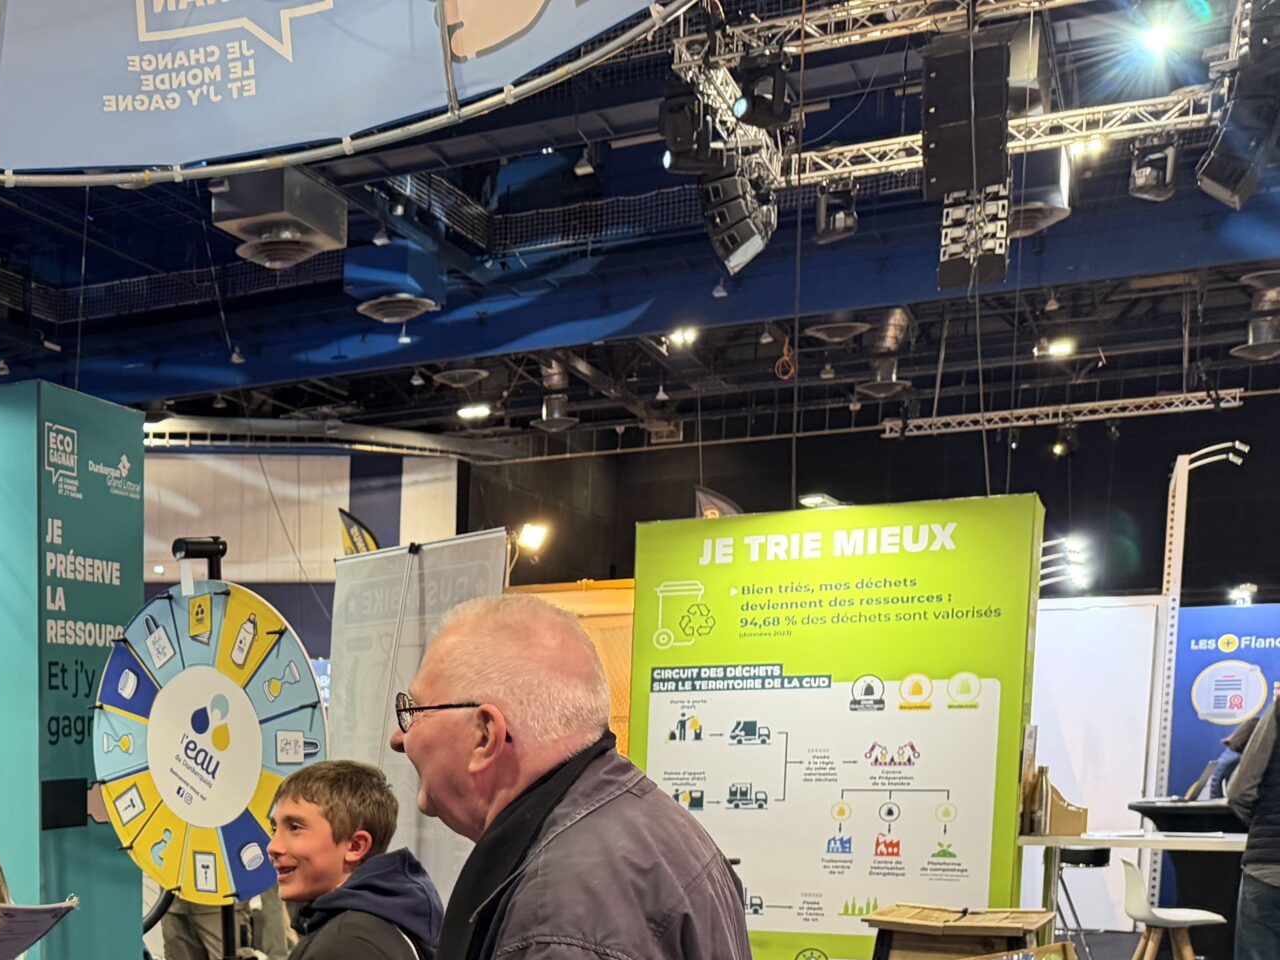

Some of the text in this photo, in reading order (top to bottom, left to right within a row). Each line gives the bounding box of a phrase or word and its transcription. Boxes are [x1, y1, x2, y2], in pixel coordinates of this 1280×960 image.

[49, 431, 73, 453] ECO
[49, 448, 78, 468] GAGNANT
[88, 460, 121, 478] Dunkerque
[46, 518, 63, 545] JE
[698, 522, 958, 567] JE TRIE MIEUX
[46, 549, 120, 586] PRÉSERVE
[741, 576, 917, 597] Bien triés, mes déchets
[46, 585, 66, 611] LA
[741, 598, 824, 613] deviennent
[829, 595, 855, 608] des
[859, 592, 943, 607] ressources
[739, 604, 1002, 630] 94,68 % des déchets sont valorisés
[1190, 638, 1216, 650] LES
[48, 659, 96, 698] Et j'y
[653, 664, 781, 680] CIRCUIT DES DÉCHETS
[652, 677, 829, 691] SUR LE TERRITOIRE DE LA CUD
[181, 733, 220, 780] l'eau
